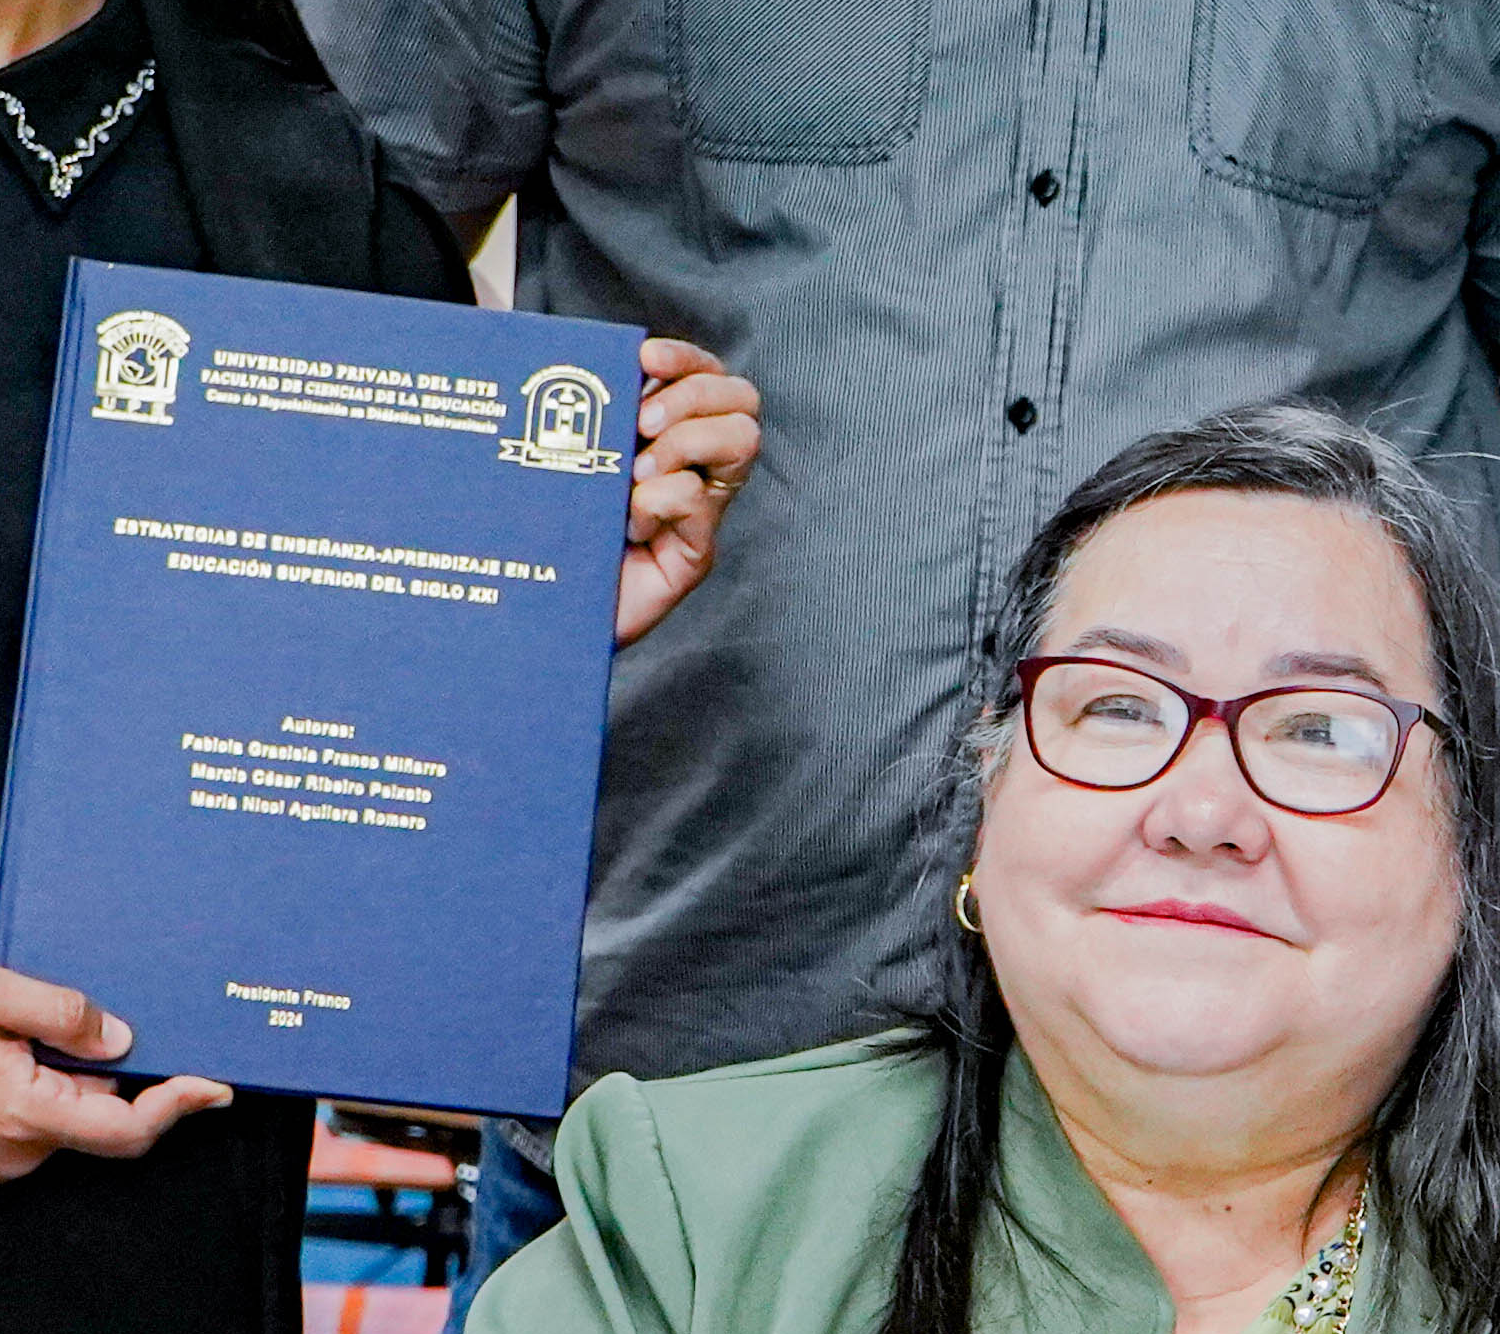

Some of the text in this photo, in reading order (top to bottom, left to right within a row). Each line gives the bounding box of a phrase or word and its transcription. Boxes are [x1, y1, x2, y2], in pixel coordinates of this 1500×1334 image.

[214, 349, 498, 398] UNIVERSIDAD PRIVADA DEL ESTE
[201, 369, 507, 417] FACULTAD DE CIENCIAS DE LA EDUCACIÓN
[114, 517, 557, 582] ESTRATEGIAS DE ENSEÑANZA-APRENDIZAJE EN LA
[167, 552, 499, 605] EDUCACIÓN SUPERIOR DEL SIGLO XXI
[281, 716, 355, 739] Autores:
[182, 733, 243, 755] Fabiola
[247, 740, 318, 763] Graciela
[322, 749, 380, 770] Franco
[190, 762, 247, 783] Marcio
[305, 774, 365, 796] Ribeiro
[362, 808, 426, 830] Romero
[226, 981, 351, 1010] Presidente Franco
[268, 1009, 303, 1027] 2024
